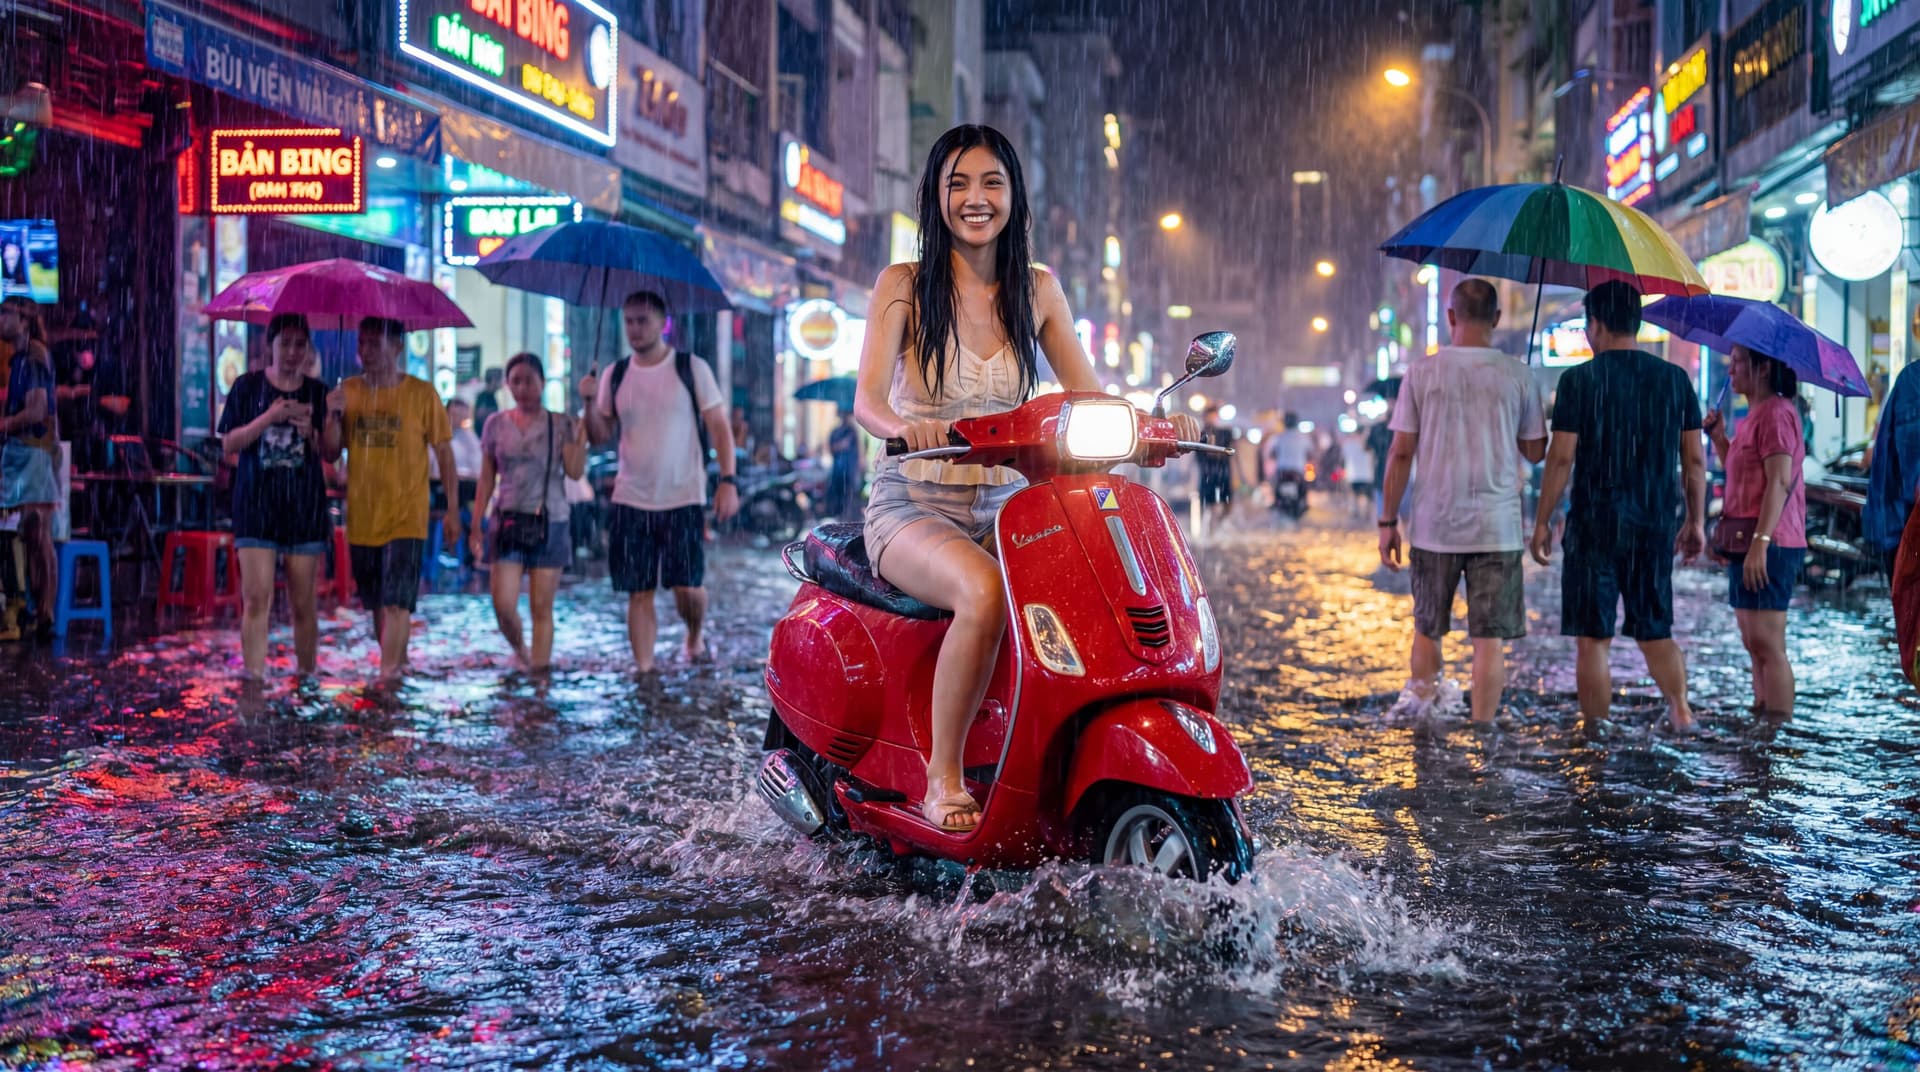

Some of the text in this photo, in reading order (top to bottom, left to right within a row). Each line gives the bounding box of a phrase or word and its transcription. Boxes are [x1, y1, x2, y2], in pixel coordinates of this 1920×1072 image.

[516, 0, 569, 61] BING
[206, 44, 242, 90] BÙI
[220, 141, 352, 176] BẢN BING
